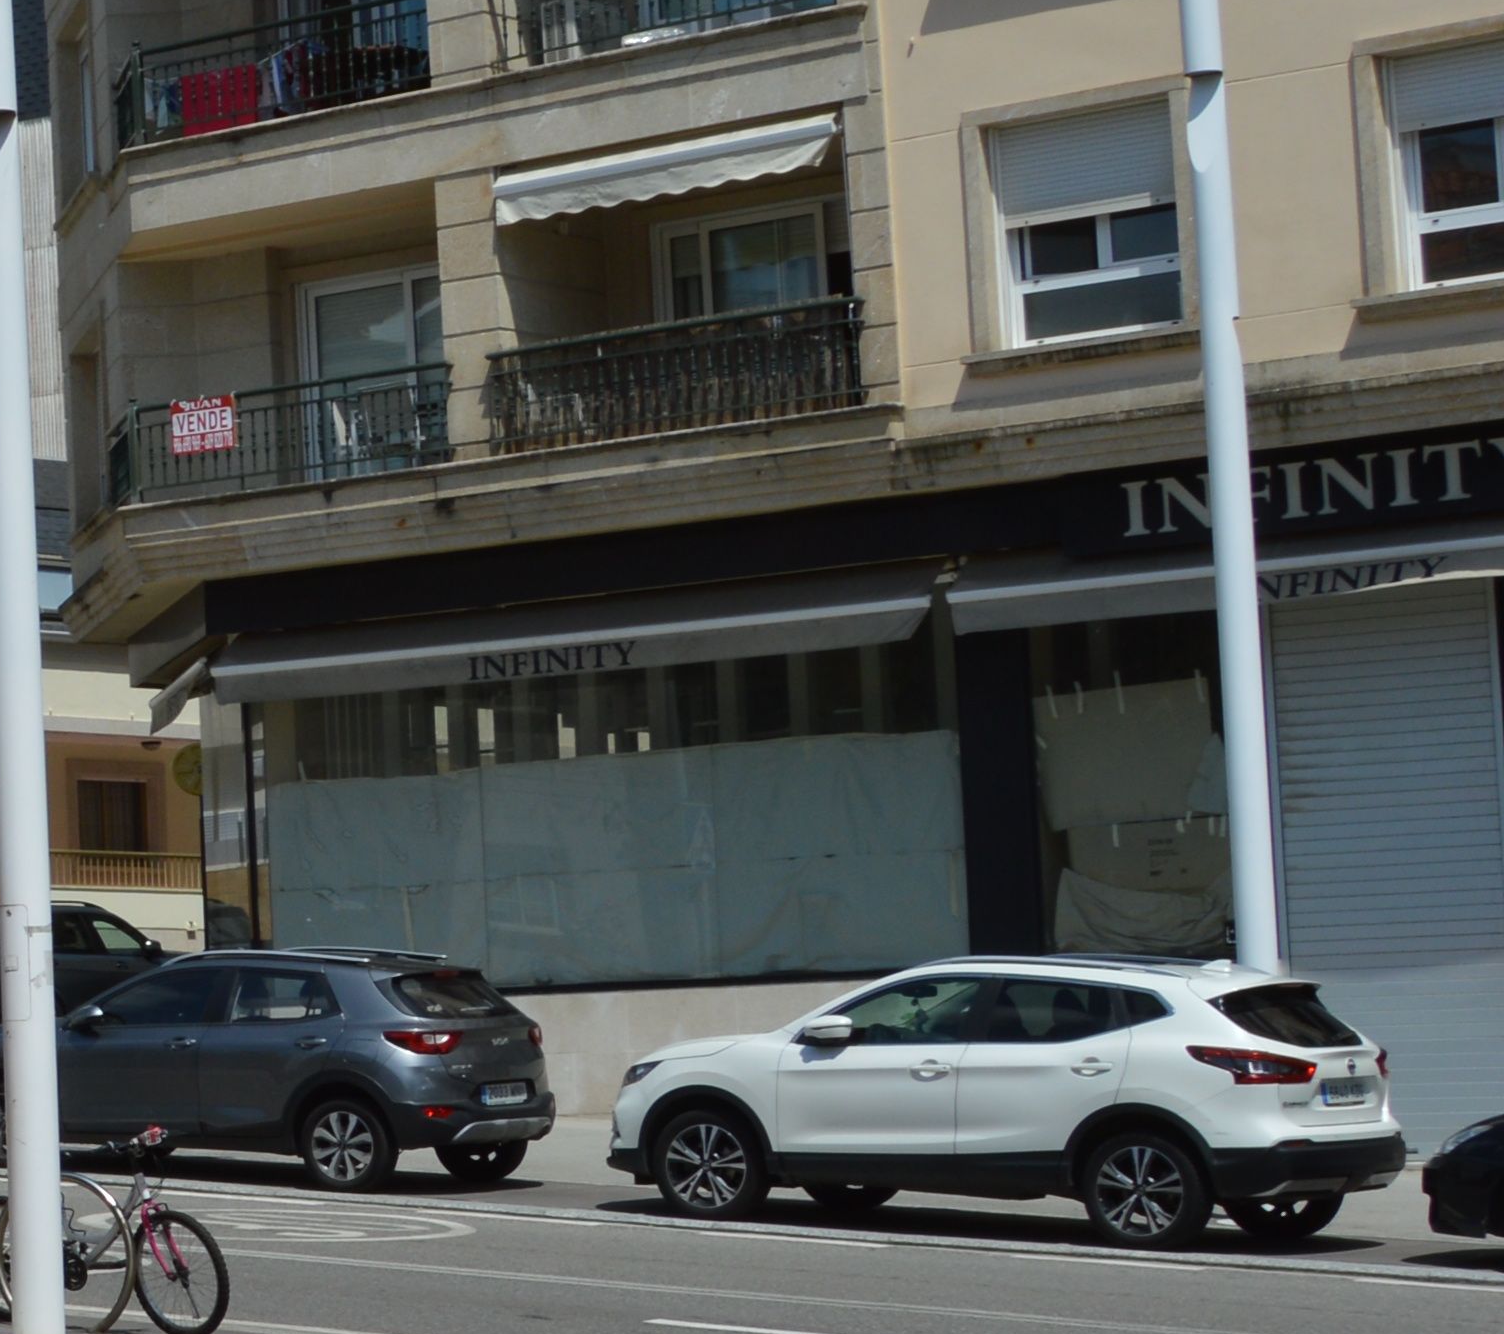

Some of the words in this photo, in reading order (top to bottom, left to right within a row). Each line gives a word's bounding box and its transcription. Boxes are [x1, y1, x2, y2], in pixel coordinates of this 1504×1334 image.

[176, 409, 228, 433] VENDE
[1120, 438, 1504, 537] INFINIT
[1256, 556, 1448, 601] NFINITY
[467, 641, 636, 681] INFINITY
